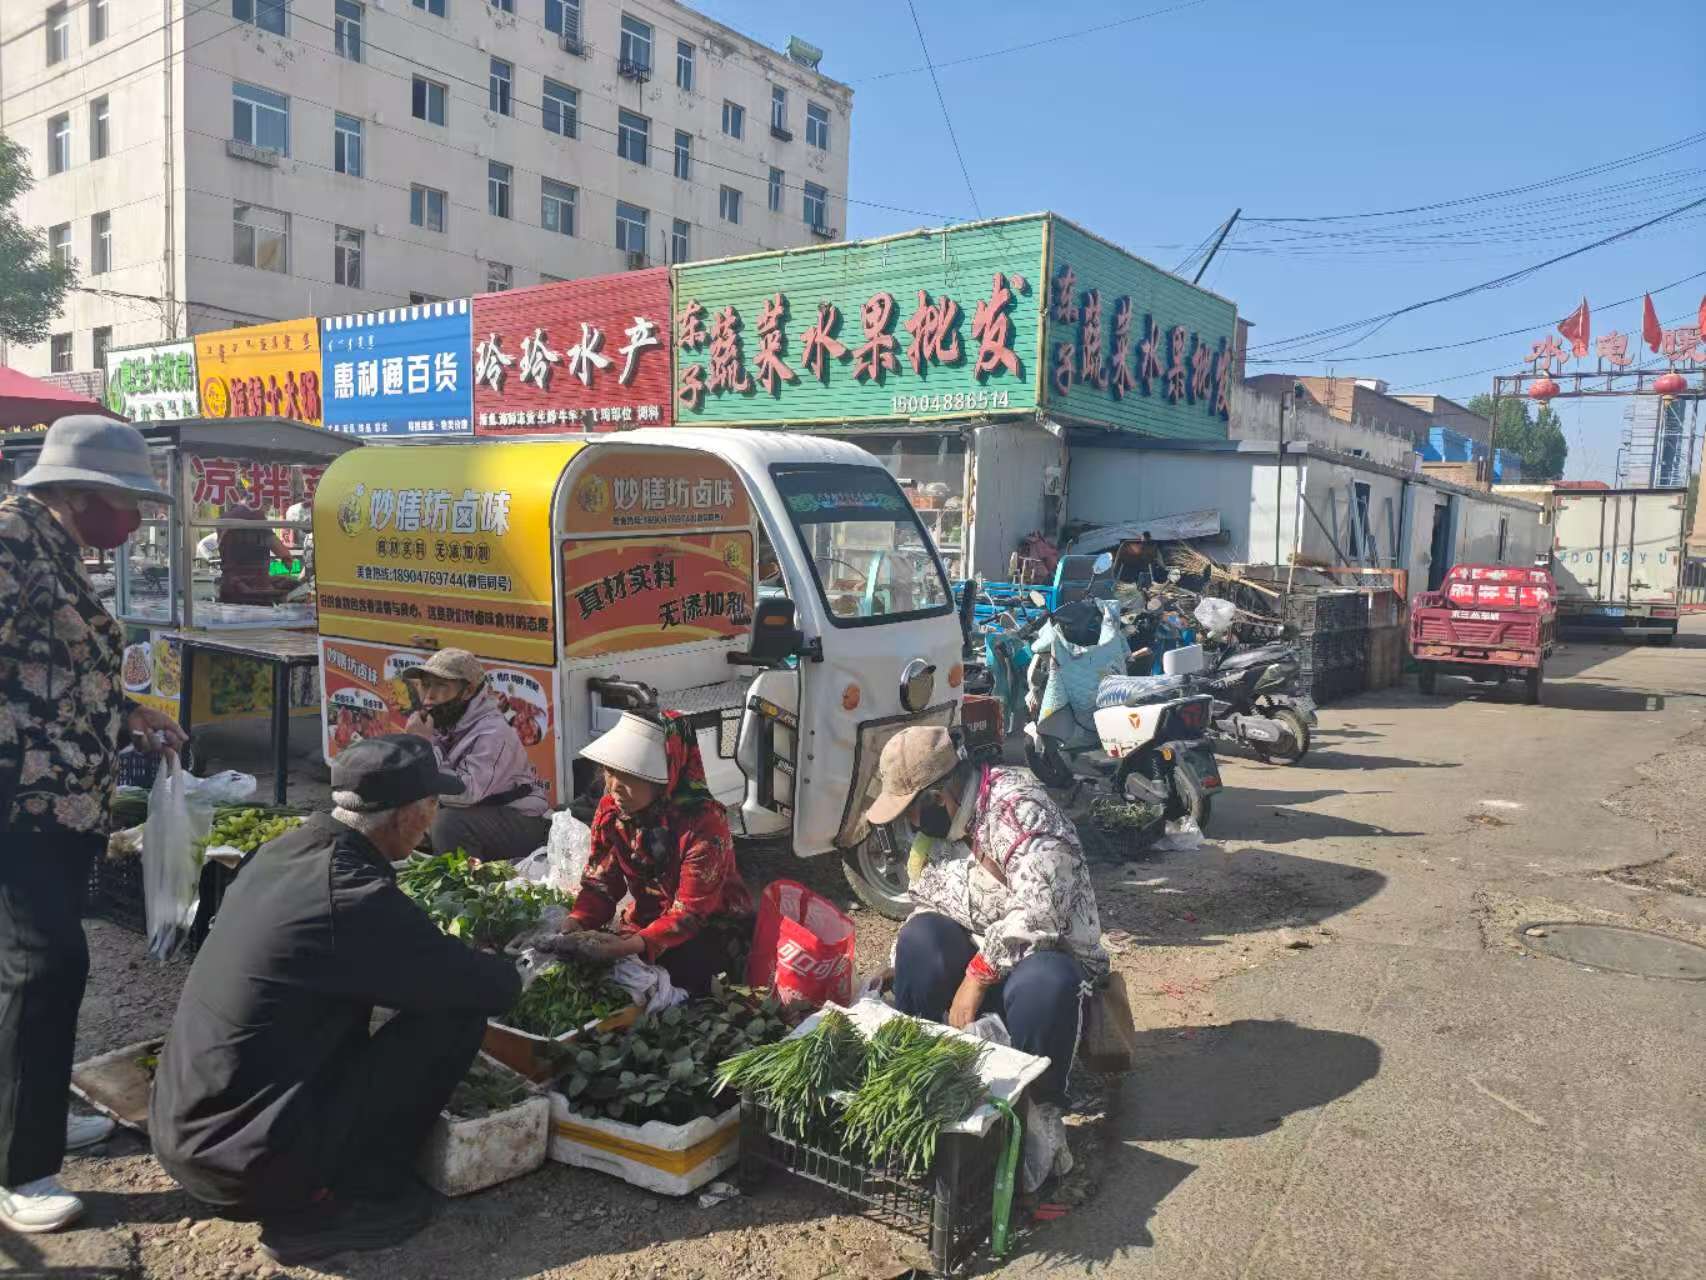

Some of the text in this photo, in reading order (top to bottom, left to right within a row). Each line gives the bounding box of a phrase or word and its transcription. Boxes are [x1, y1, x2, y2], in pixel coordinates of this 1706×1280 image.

[475, 316, 659, 393] 玲玲水产
[708, 272, 1026, 398] 蔬菜水果批发
[1082, 287, 1232, 420] 蔬菜水果批发
[334, 352, 458, 400] 惠利通百货
[892, 390, 1009, 414] 15004886514
[370, 488, 512, 537] 妙膳坊卤味
[612, 477, 735, 512] 妙膳坊卤味
[575, 560, 677, 620] 真材实料
[658, 591, 747, 630] 无添加剂
